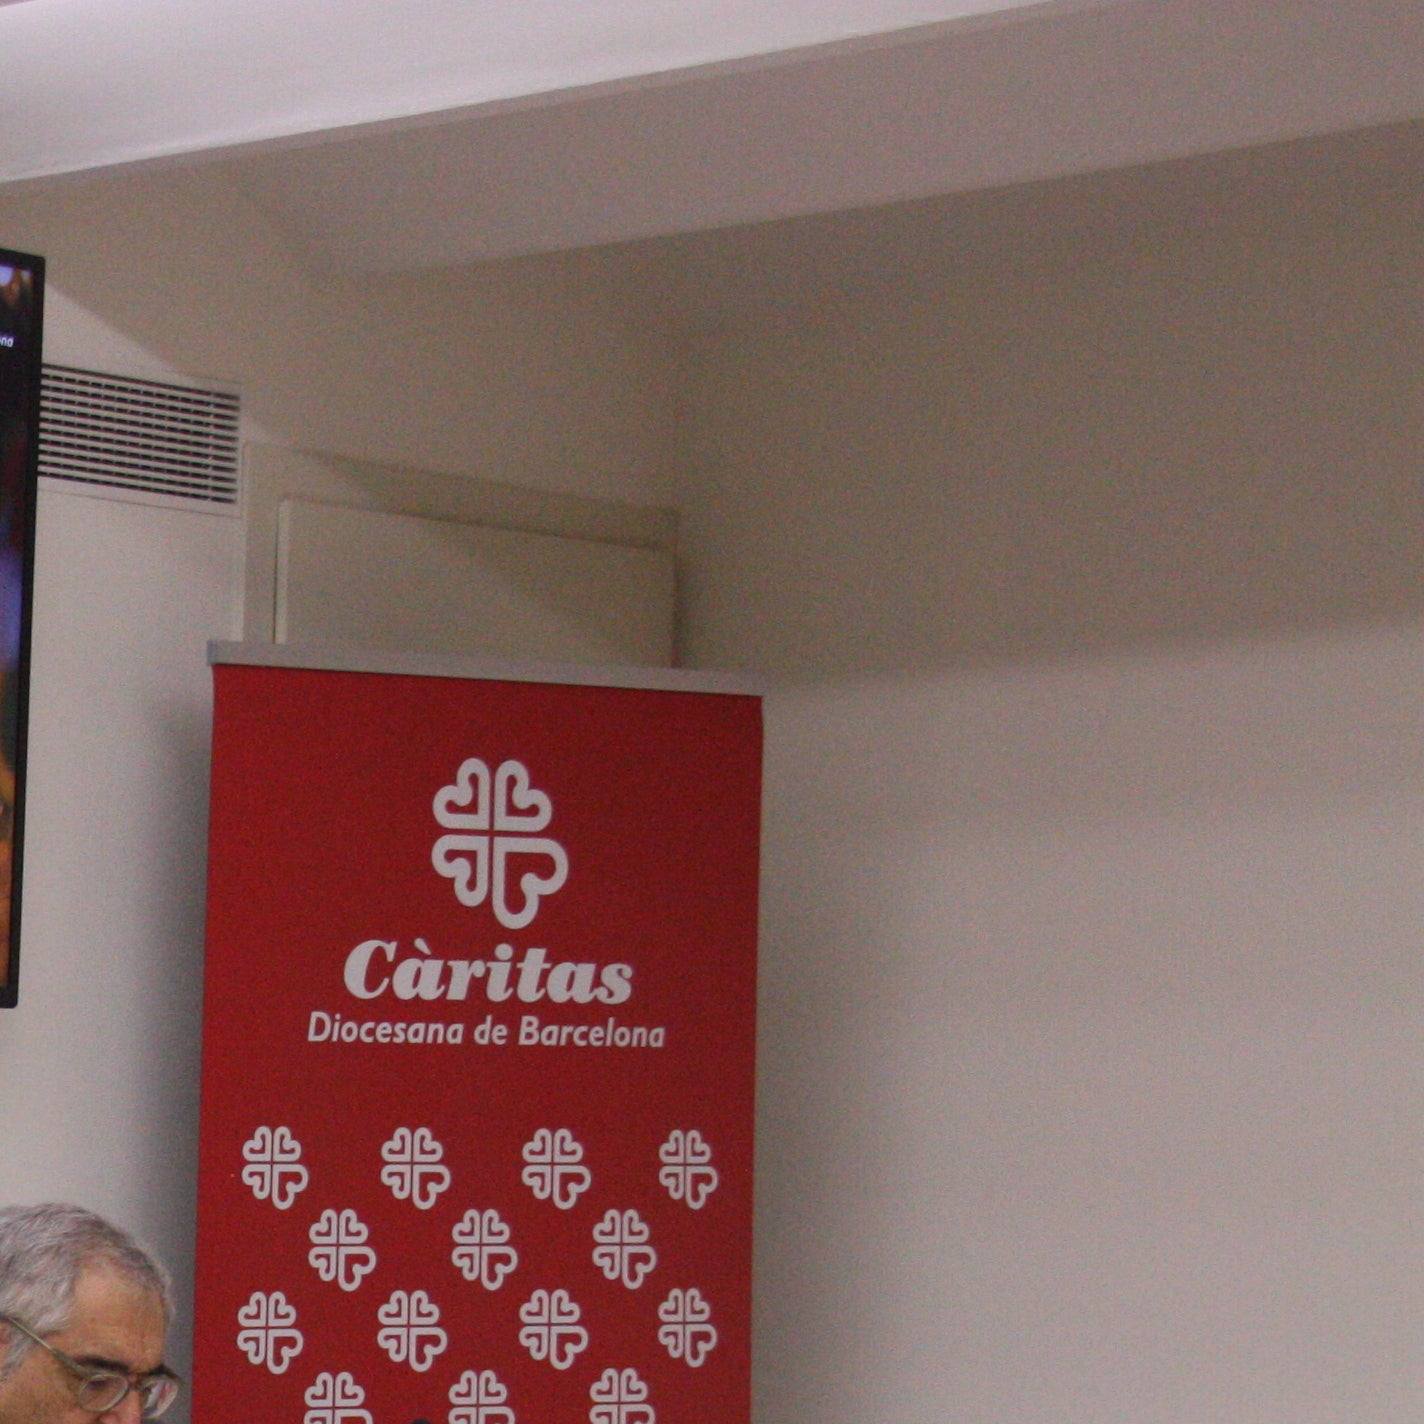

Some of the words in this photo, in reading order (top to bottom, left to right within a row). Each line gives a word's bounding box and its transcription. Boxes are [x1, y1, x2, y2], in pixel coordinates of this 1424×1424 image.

[343, 937, 633, 1005] Càritas
[307, 1010, 464, 1045] Diocesana
[473, 1014, 508, 1046] de
[518, 1015, 666, 1048] Barcelona
